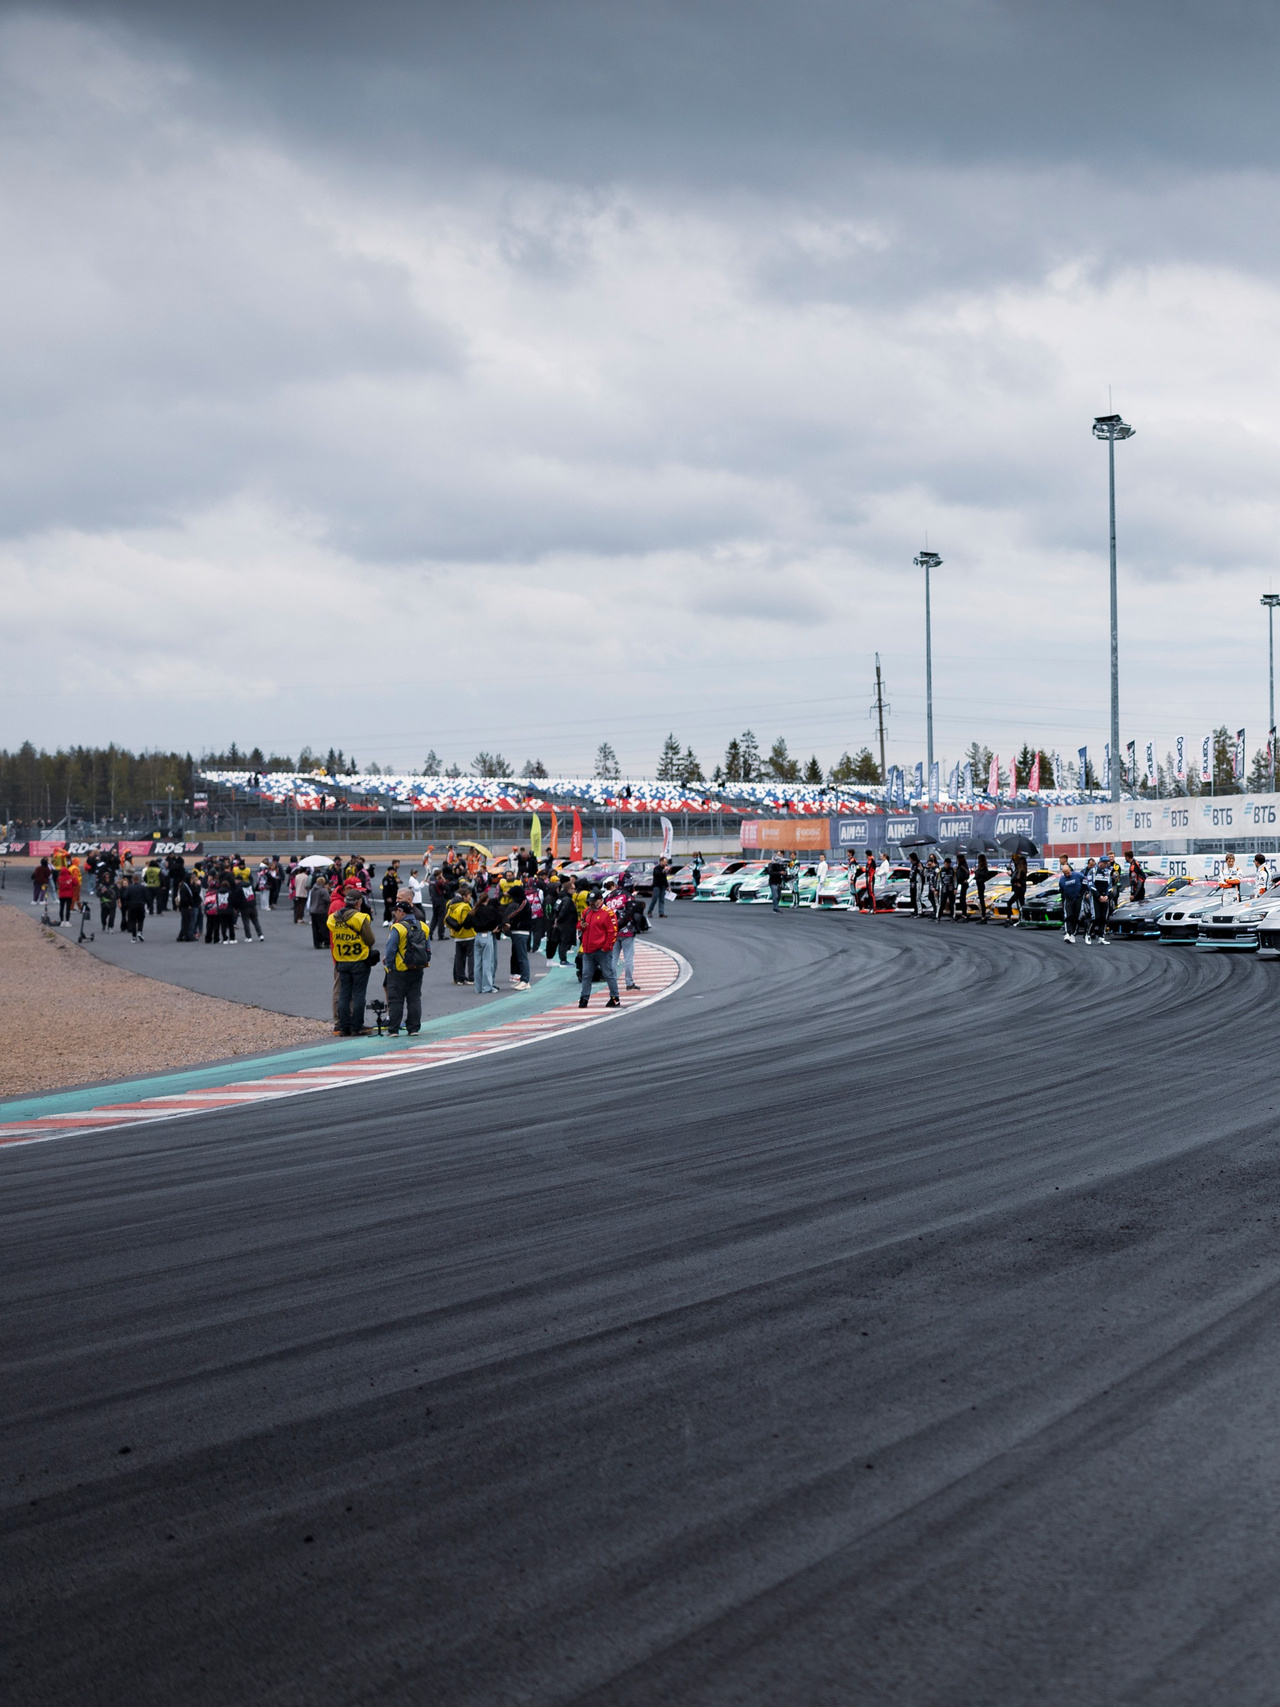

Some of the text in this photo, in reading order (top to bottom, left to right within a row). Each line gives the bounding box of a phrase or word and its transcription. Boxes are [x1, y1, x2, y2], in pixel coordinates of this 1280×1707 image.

[1135, 812, 1152, 828] ВТБ
[1171, 810, 1189, 827] ВТБ
[1213, 808, 1233, 825] ВТБ
[1253, 805, 1276, 823] ВТБ
[1061, 817, 1078, 833] ВТБ
[1094, 815, 1112, 831] ВТБ
[841, 824, 867, 840] AIMOL
[1169, 860, 1187, 876] ВТБ
[336, 943, 362, 957] 128
